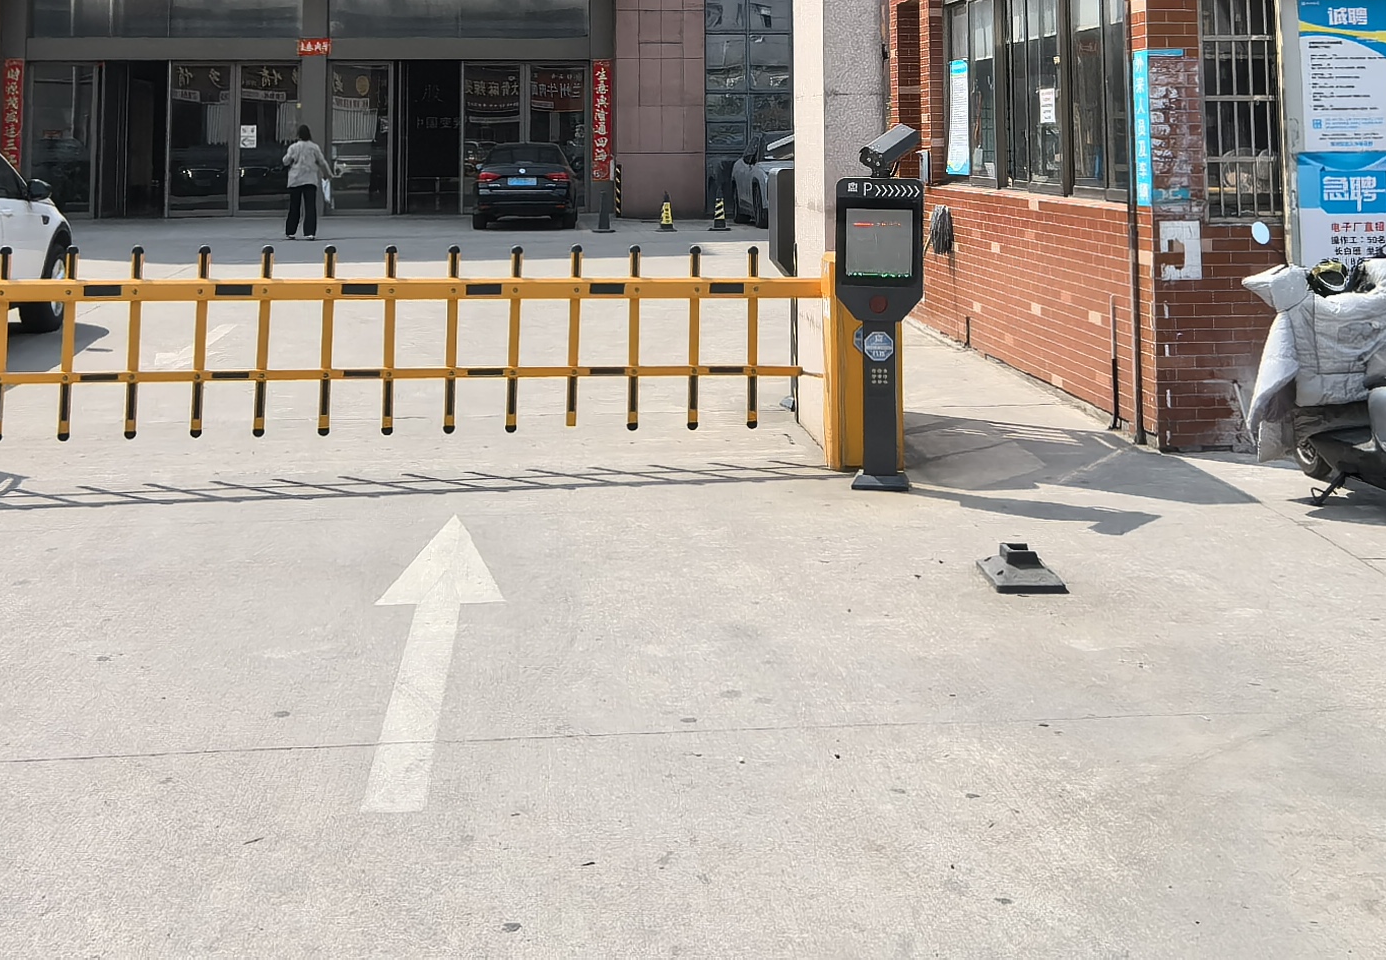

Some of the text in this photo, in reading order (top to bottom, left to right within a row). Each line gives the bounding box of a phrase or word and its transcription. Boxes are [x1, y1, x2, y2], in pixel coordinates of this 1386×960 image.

[1327, 6, 1368, 26] 诚聘
[1133, 56, 1149, 201] 外来人员及车辆
[863, 182, 873, 196] P
[1322, 175, 1386, 212] 急聘
[1331, 221, 1385, 233] 电子厂直招
